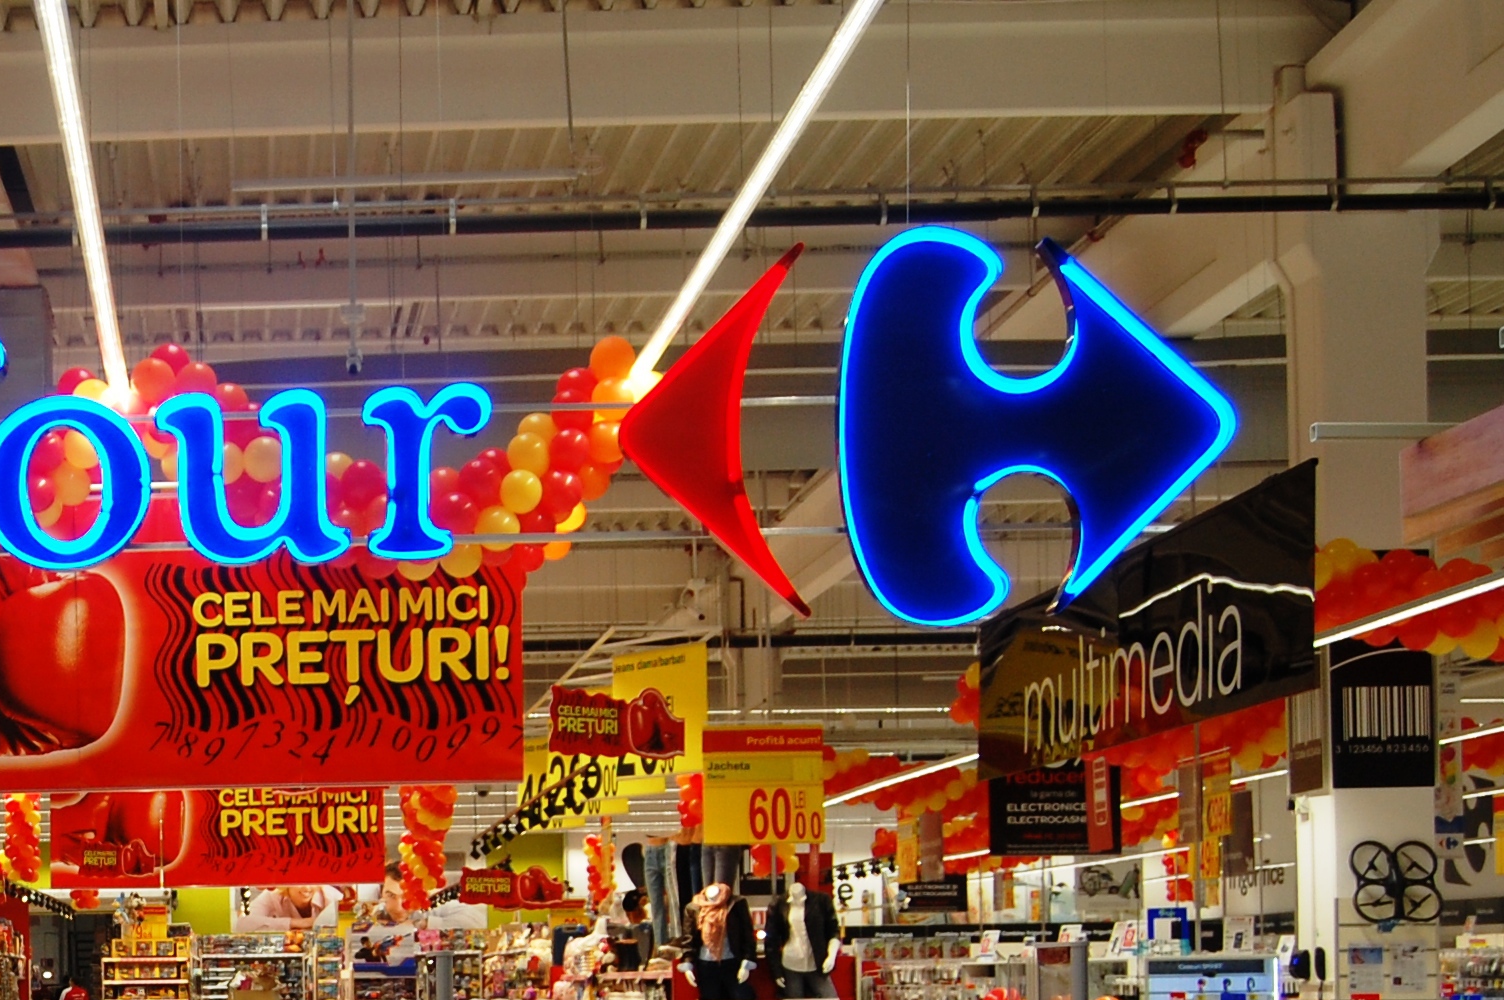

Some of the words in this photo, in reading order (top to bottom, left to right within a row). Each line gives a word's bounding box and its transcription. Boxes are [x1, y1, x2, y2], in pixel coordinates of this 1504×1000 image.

[192, 590, 305, 627] CELE
[312, 587, 389, 624] MAI
[399, 585, 489, 622] MICI
[195, 625, 510, 706] PREȚURI!
[1023, 583, 1242, 755] multimedia
[558, 705, 581, 716] CELE
[558, 716, 618, 739] PREȚURI
[1348, 744, 1383, 754] 123456
[1386, 743, 1429, 753] 823456
[707, 762, 750, 771] Jacheta
[218, 788, 276, 807] CELE
[1006, 802, 1087, 812] ELECTRONICE
[220, 804, 378, 846] PREȚURI!
[749, 787, 791, 841] 60
